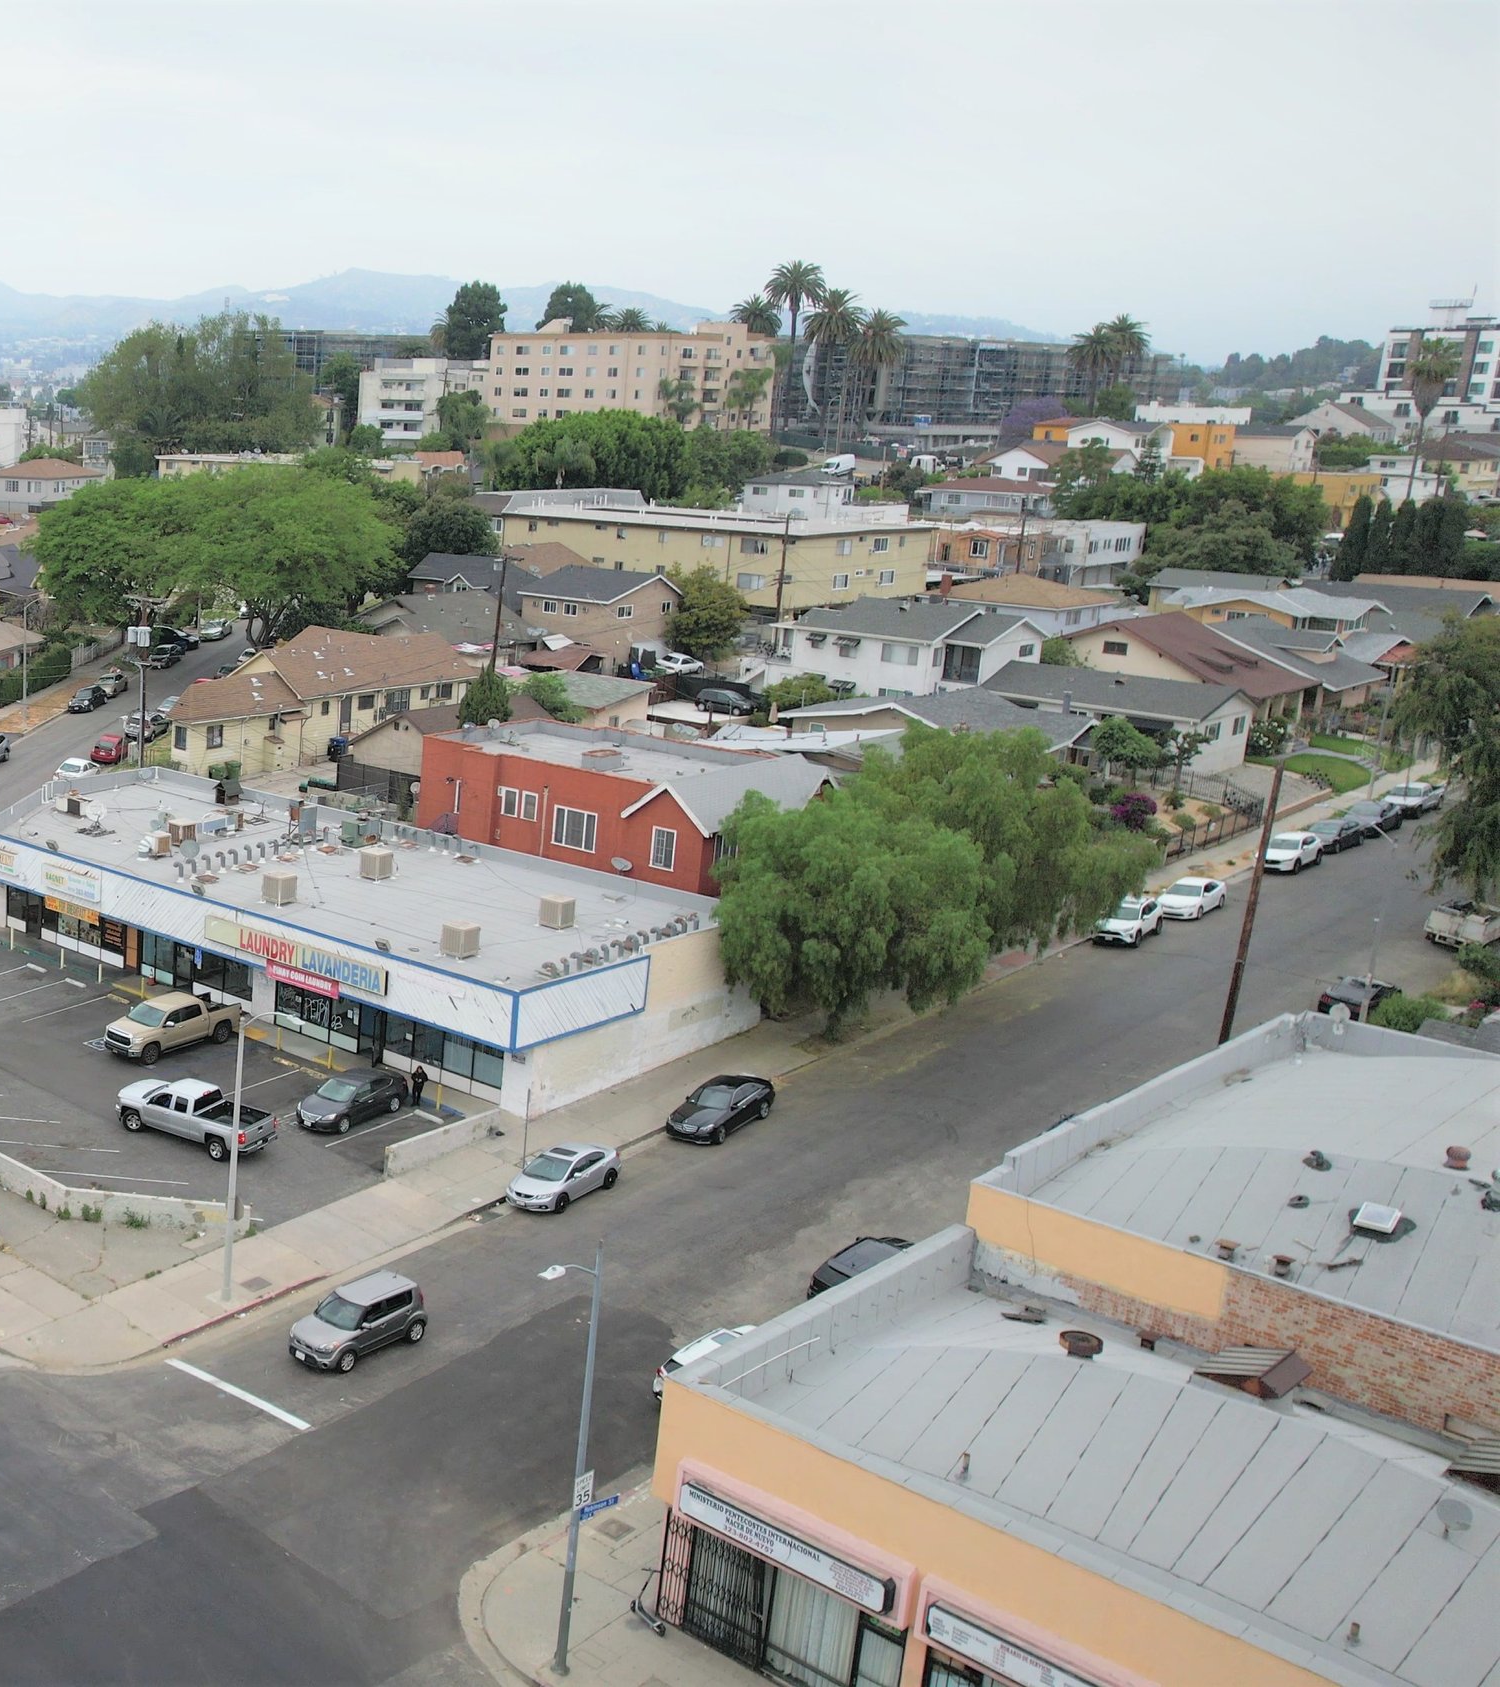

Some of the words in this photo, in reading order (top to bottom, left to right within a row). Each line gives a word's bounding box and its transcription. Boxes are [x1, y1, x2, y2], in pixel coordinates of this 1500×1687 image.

[239, 928, 296, 964] LAUNDRY
[301, 947, 381, 993] LAVANDERIA
[290, 969, 306, 983] COIN
[305, 973, 333, 991] LAUNDRY
[575, 1489, 590, 1507] 35
[688, 1489, 725, 1513] MINISTERIO
[724, 1508, 768, 1535] PENTECOSTES
[767, 1528, 821, 1562] INTERNACIONAL
[725, 1516, 744, 1533] NACER
[745, 1526, 754, 1538] DE
[754, 1530, 774, 1547] NUEVO
